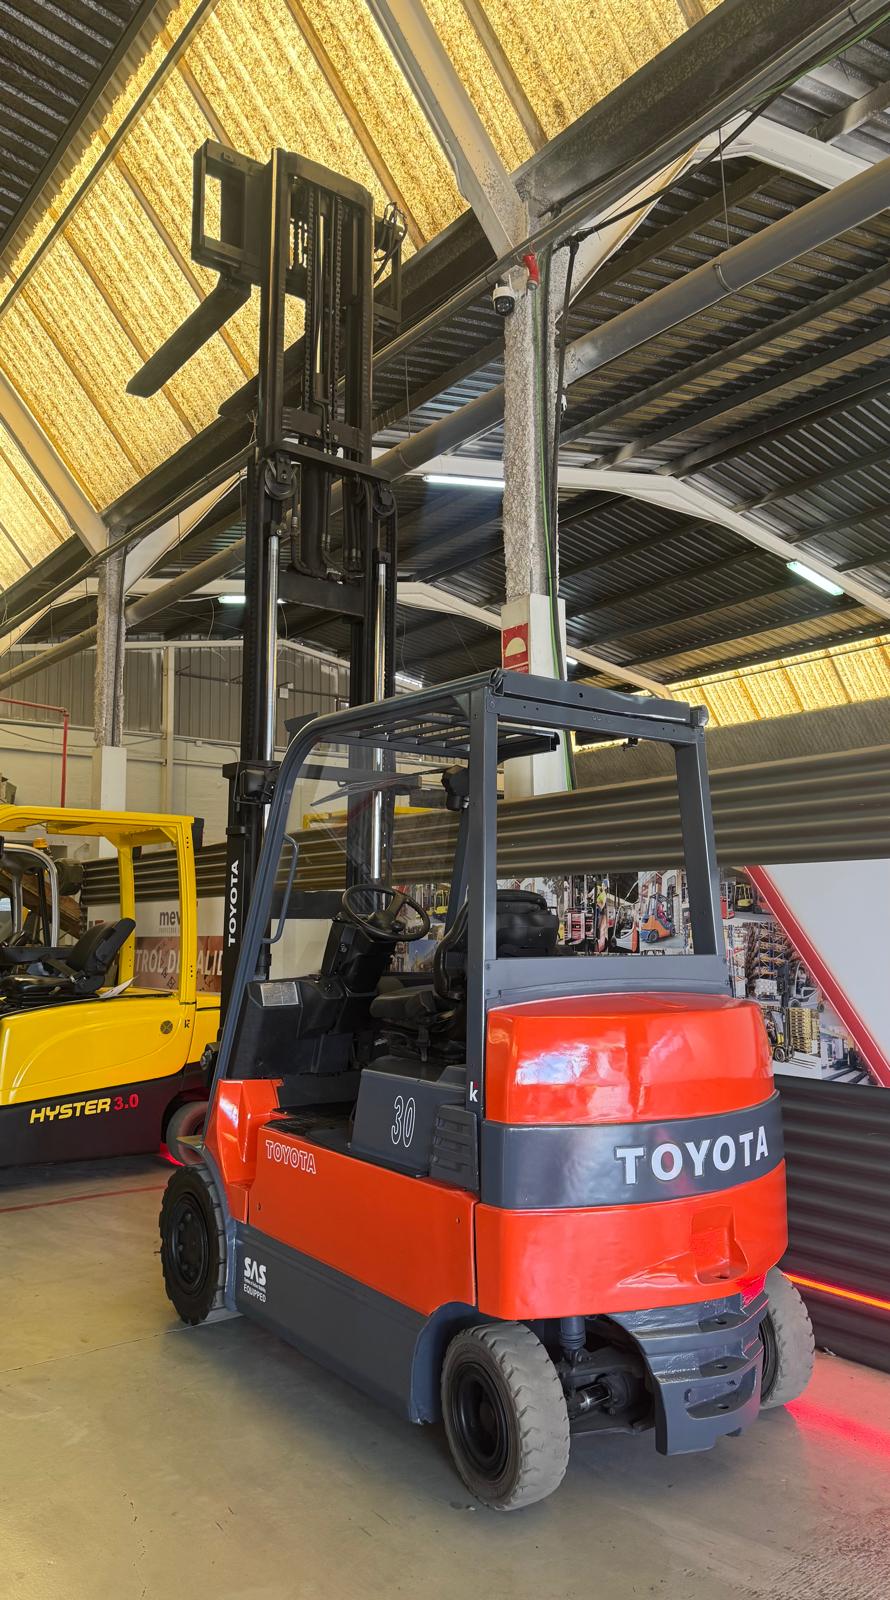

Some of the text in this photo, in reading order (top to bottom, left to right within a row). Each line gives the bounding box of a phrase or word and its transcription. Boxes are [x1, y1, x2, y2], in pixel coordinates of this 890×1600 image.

[227, 859, 239, 948] TOYOTA
[29, 1093, 139, 1124] HYSTER 3.0
[391, 1095, 416, 1148] 30
[265, 1139, 316, 1175] TOYOTA
[615, 1125, 769, 1185] TOYOTA
[243, 1256, 267, 1286] SAS
[243, 1283, 267, 1303] EQUIPPED
